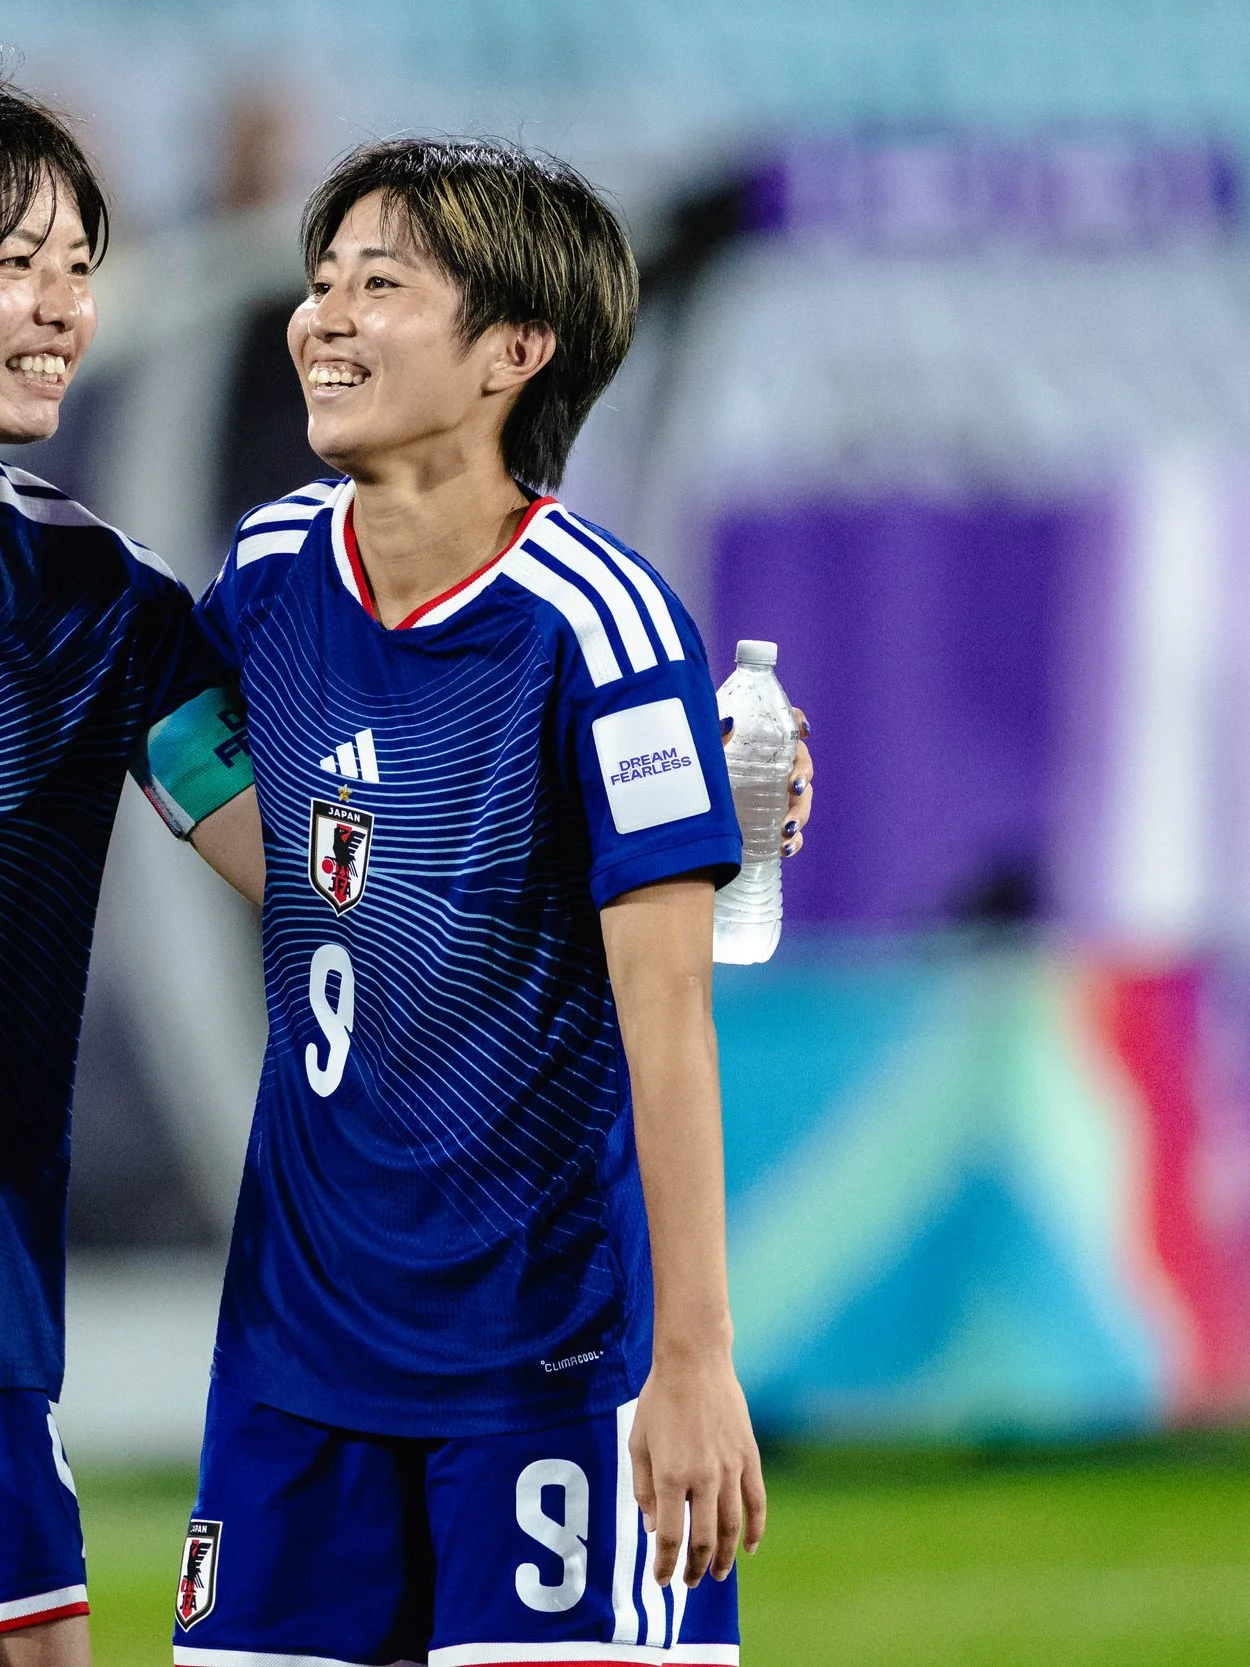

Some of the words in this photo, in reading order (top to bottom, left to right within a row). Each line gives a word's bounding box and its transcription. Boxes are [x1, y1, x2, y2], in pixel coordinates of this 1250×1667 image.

[610, 756, 692, 786] FEARLESS
[619, 747, 678, 772] DREAM
[328, 807, 361, 823] JAPAN
[327, 876, 351, 898] JFA
[305, 943, 355, 1098] 9
[515, 1458, 590, 1613] 9
